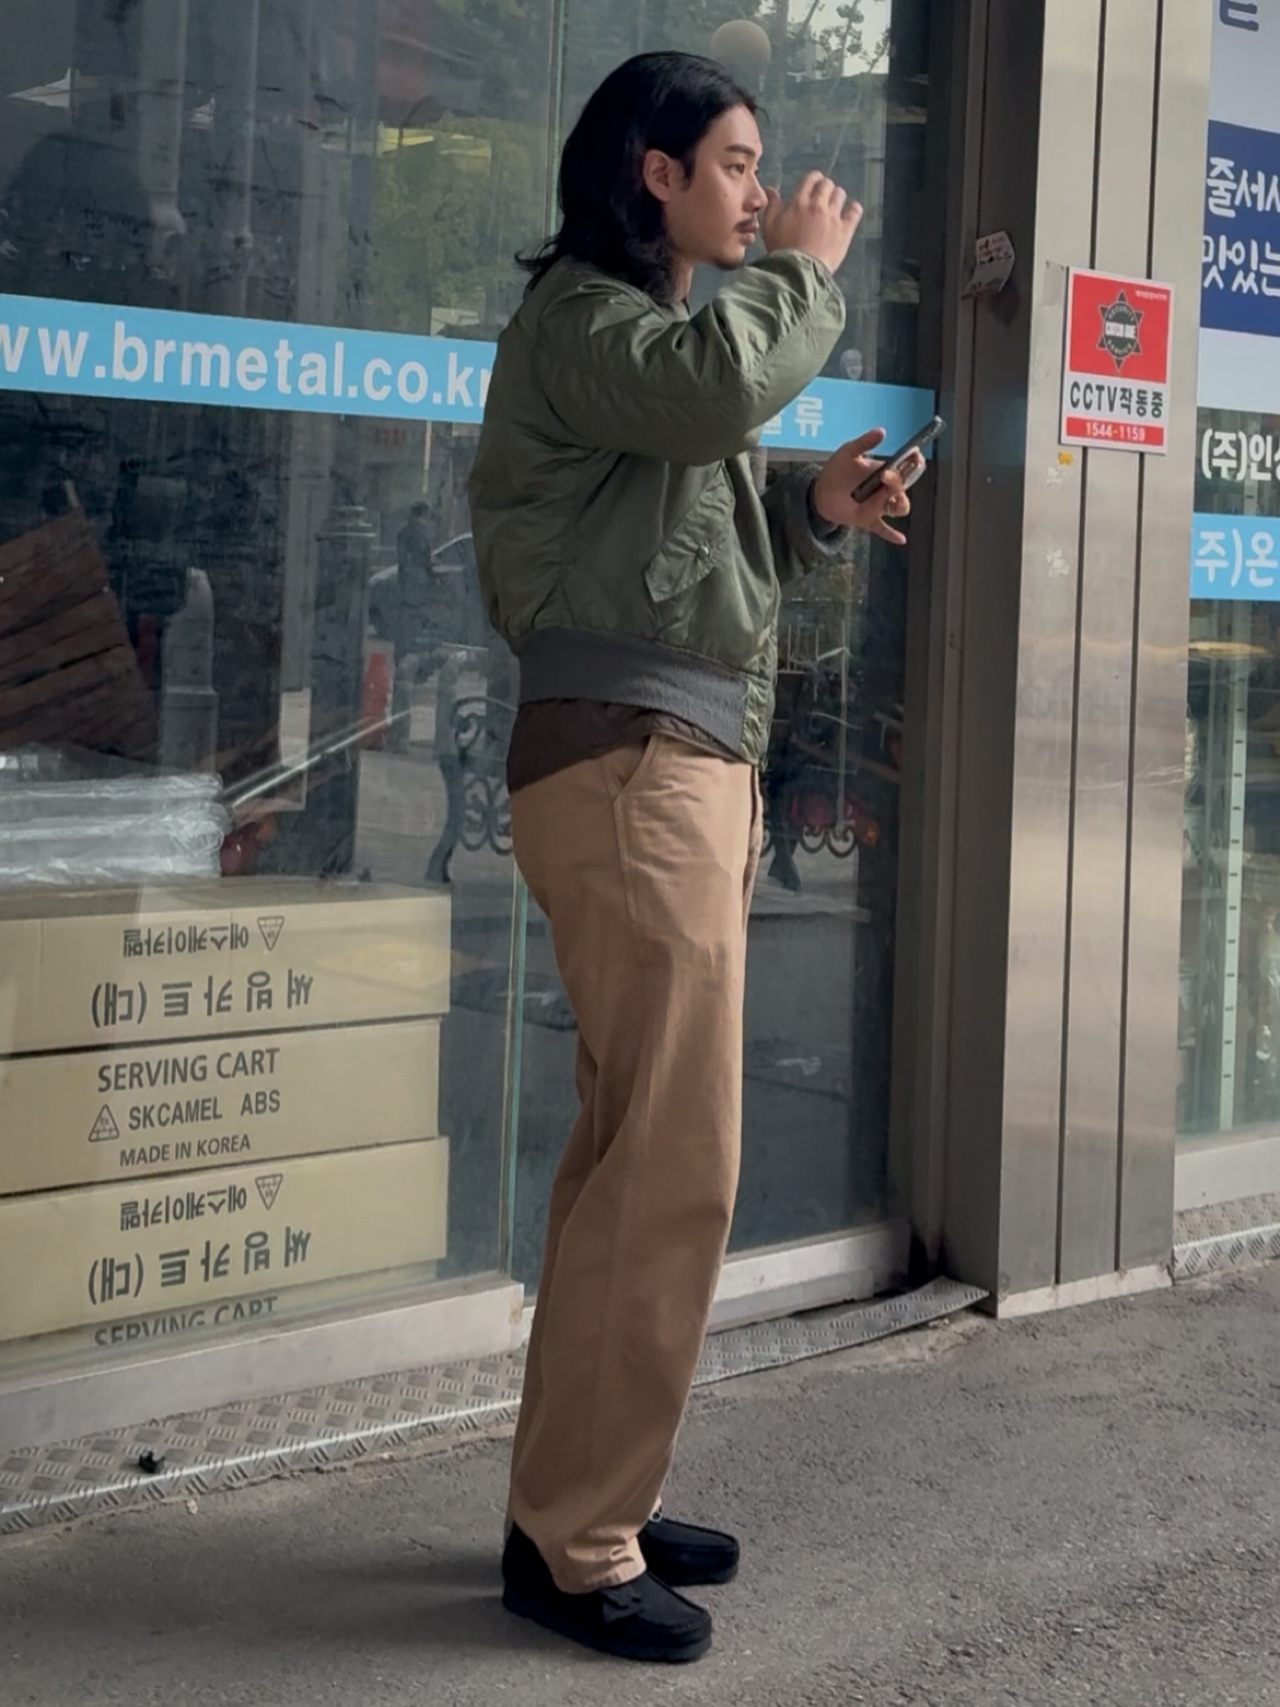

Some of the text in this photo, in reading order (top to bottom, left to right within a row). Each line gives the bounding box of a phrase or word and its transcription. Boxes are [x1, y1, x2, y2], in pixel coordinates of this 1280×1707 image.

[763, 395, 824, 438] 류
[1070, 381, 1163, 418] CCTV작동중
[1086, 422, 1146, 442] 1544-1159
[1202, 428, 1280, 481] (주)인
[123, 922, 249, 957] 에스케이카멜
[98, 1048, 280, 1092] SERVING CART
[129, 1090, 280, 1130] SKCAMEL ABS
[120, 1134, 250, 1167] MADE IN KOREA
[120, 1185, 247, 1231] 에스케이카멜
